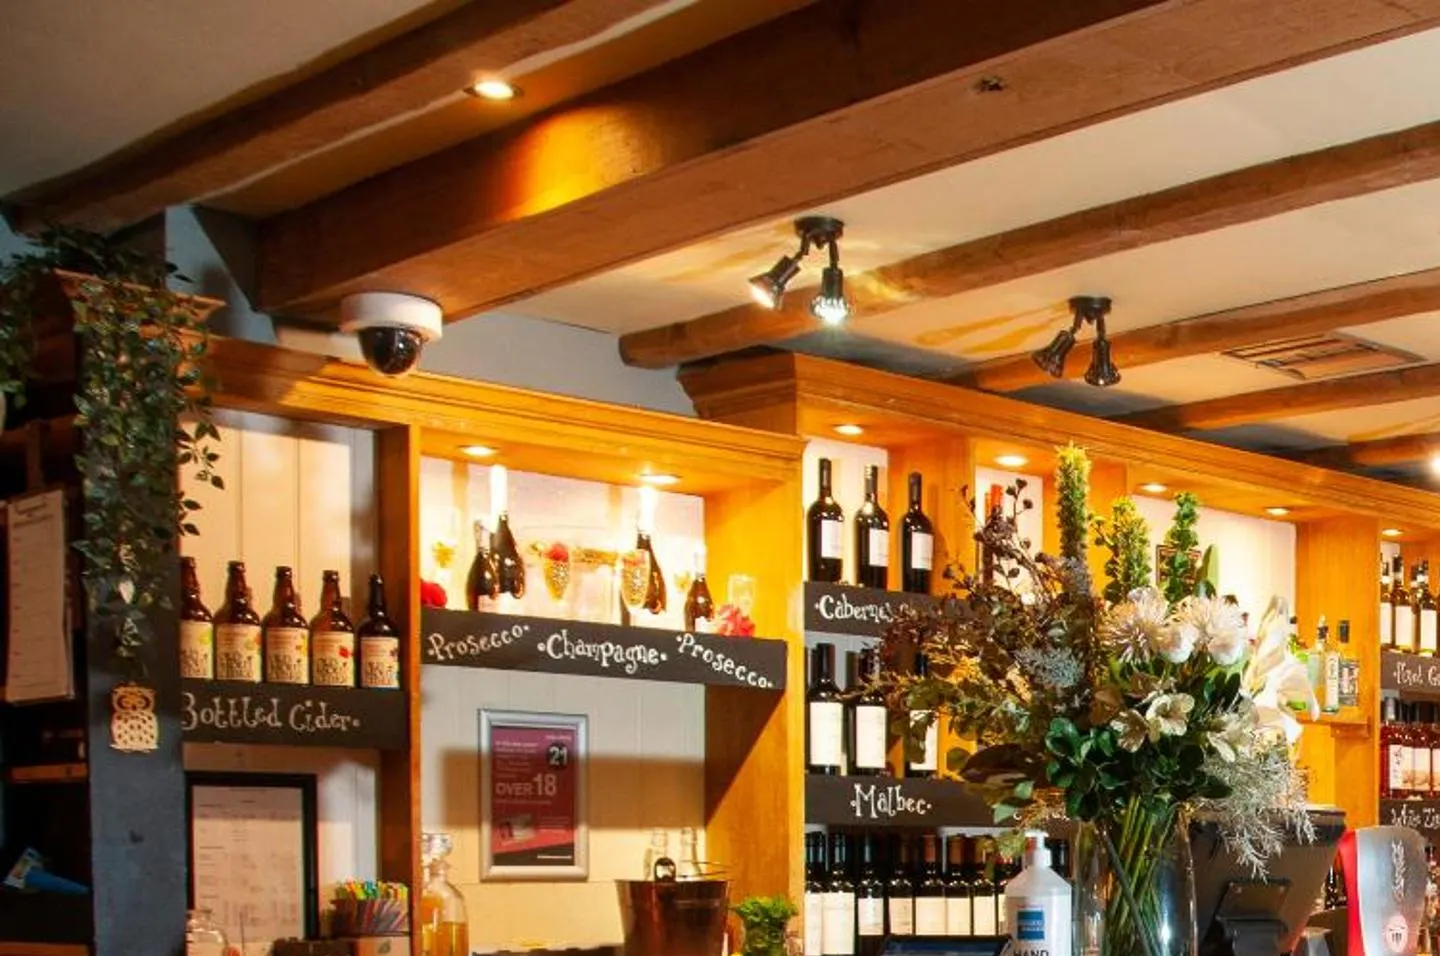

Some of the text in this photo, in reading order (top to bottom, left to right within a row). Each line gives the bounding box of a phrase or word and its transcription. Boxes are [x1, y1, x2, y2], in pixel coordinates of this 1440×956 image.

[430, 624, 768, 689] Prosecco Champagne Prosecco
[495, 773, 558, 797] OVER 18
[853, 783, 927, 819] Malbec
